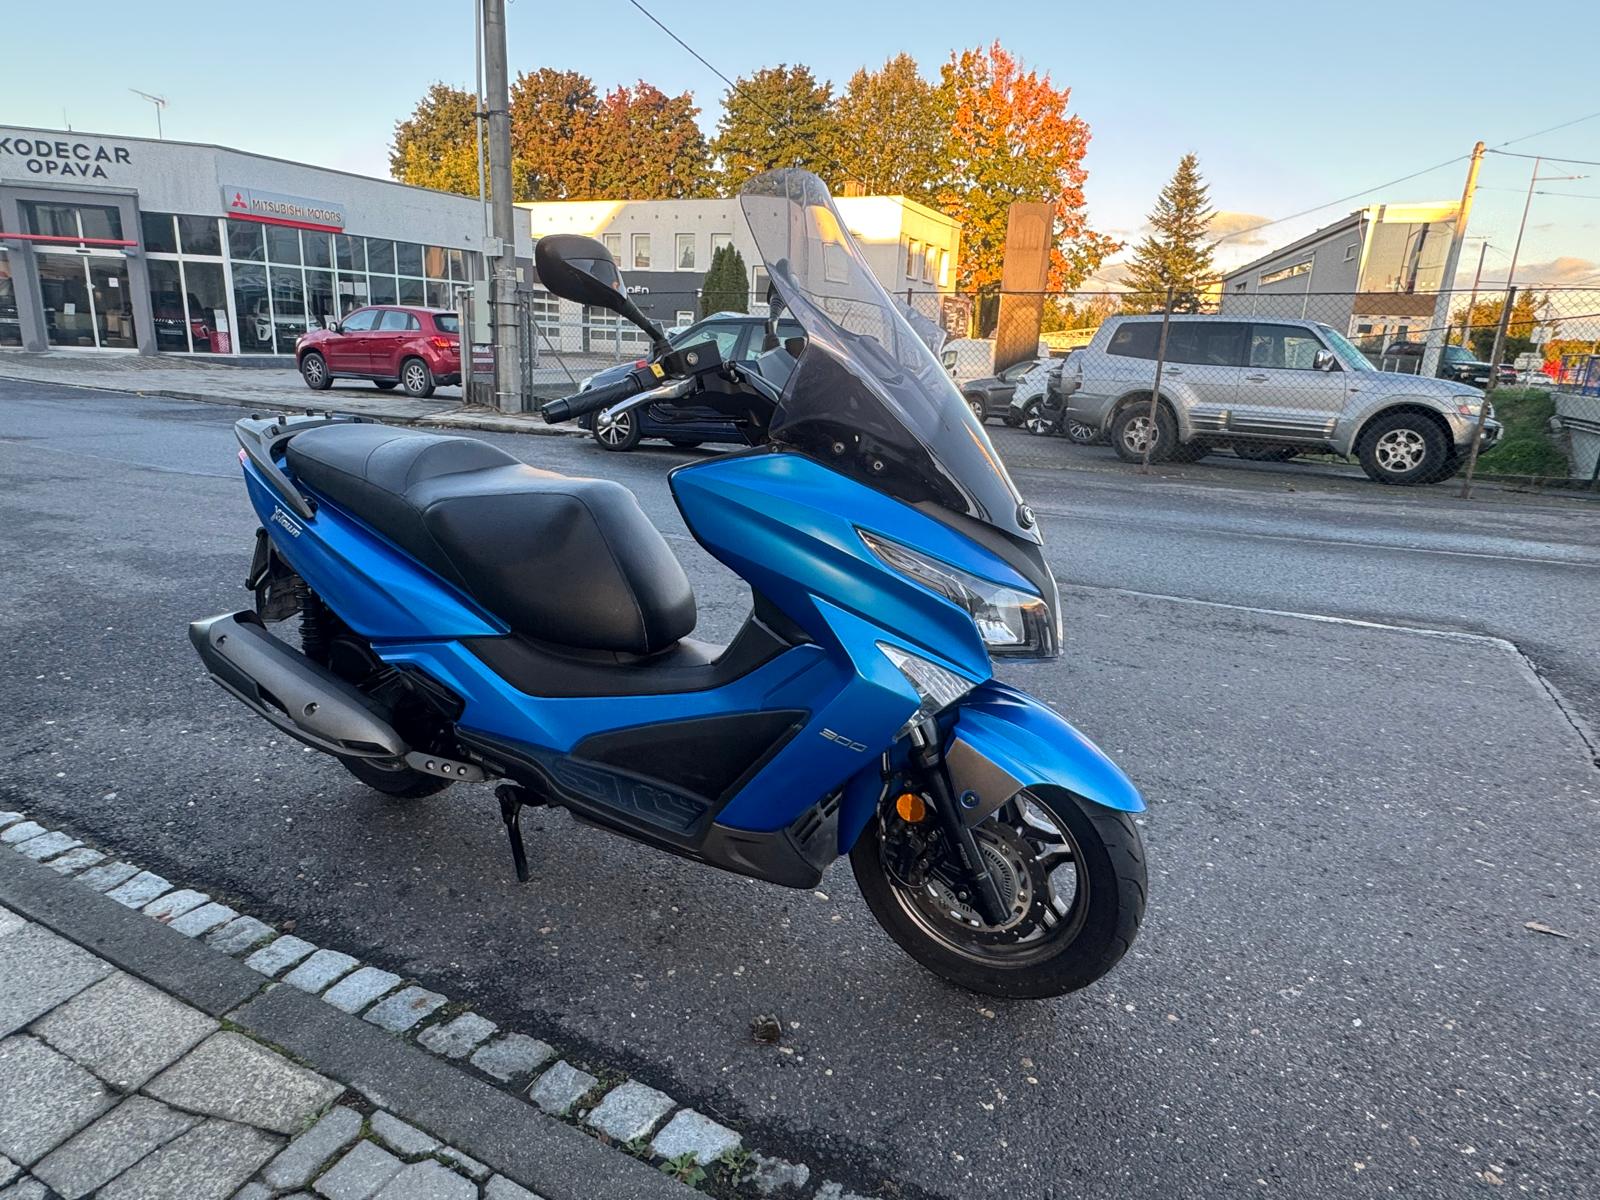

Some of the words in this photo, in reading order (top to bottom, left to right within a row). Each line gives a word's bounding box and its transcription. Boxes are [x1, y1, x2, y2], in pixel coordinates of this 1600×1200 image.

[26, 159, 109, 179] OPAVA
[252, 199, 304, 217] MITSUBISHI
[307, 208, 342, 223] MOTORS
[819, 728, 868, 752] 300
